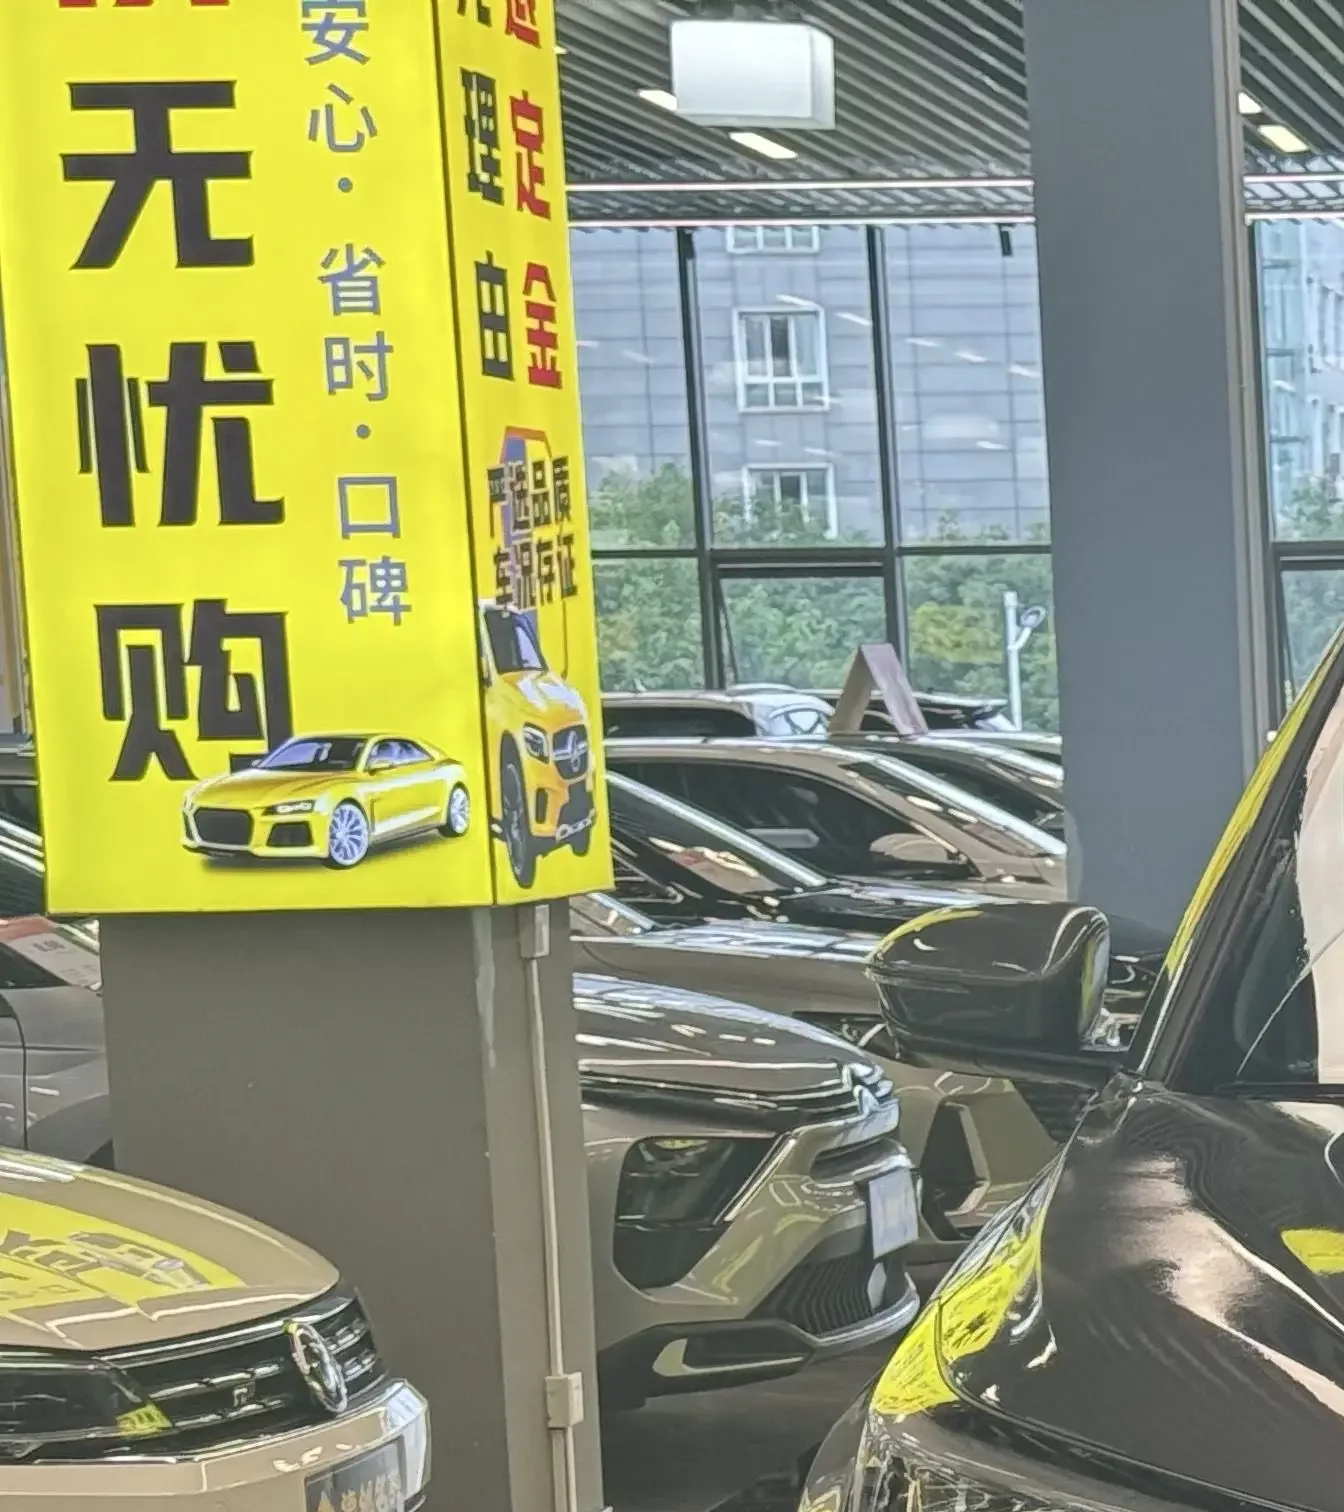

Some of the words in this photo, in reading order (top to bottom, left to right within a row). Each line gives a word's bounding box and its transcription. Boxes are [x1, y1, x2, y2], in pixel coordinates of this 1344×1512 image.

[457, 0, 514, 383] 理由
[59, 0, 294, 782] 无忧购
[487, 456, 572, 538] 严选品质
